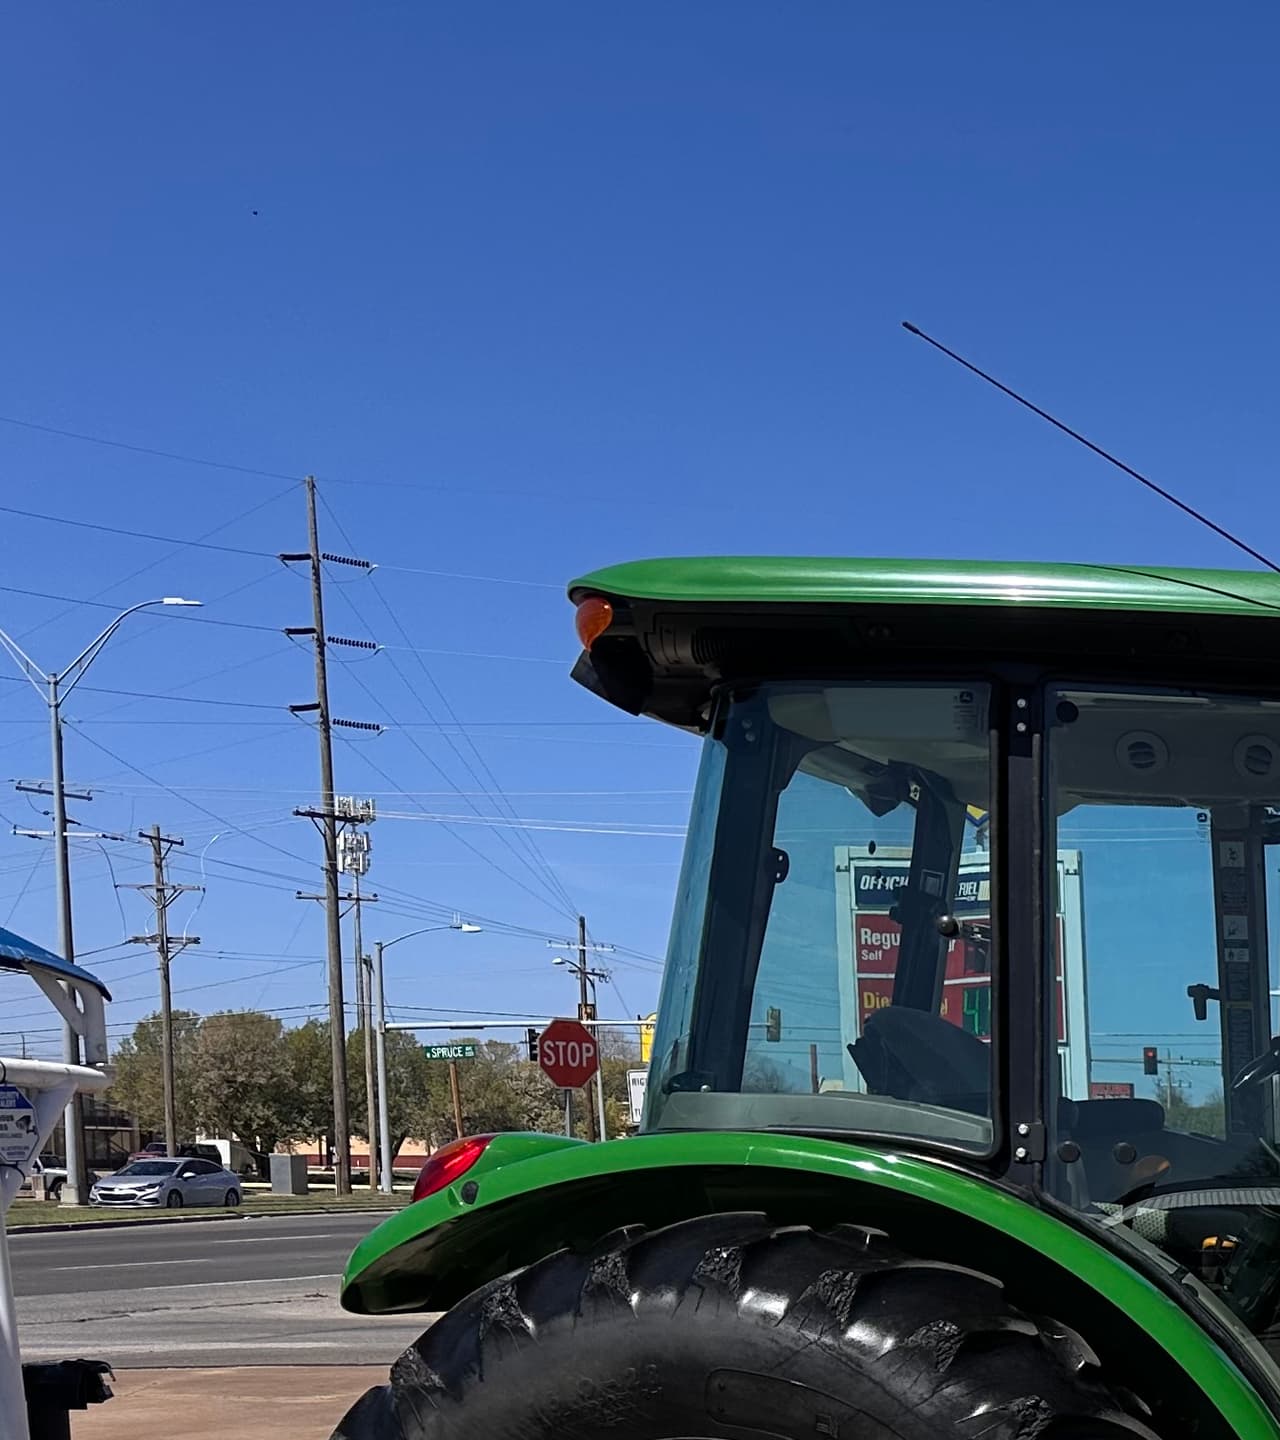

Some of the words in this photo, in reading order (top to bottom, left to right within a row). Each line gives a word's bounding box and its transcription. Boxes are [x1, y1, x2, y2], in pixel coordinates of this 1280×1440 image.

[861, 949, 882, 961] Self
[431, 1047, 464, 1059] SPRUCE
[543, 1041, 595, 1067] STOP
